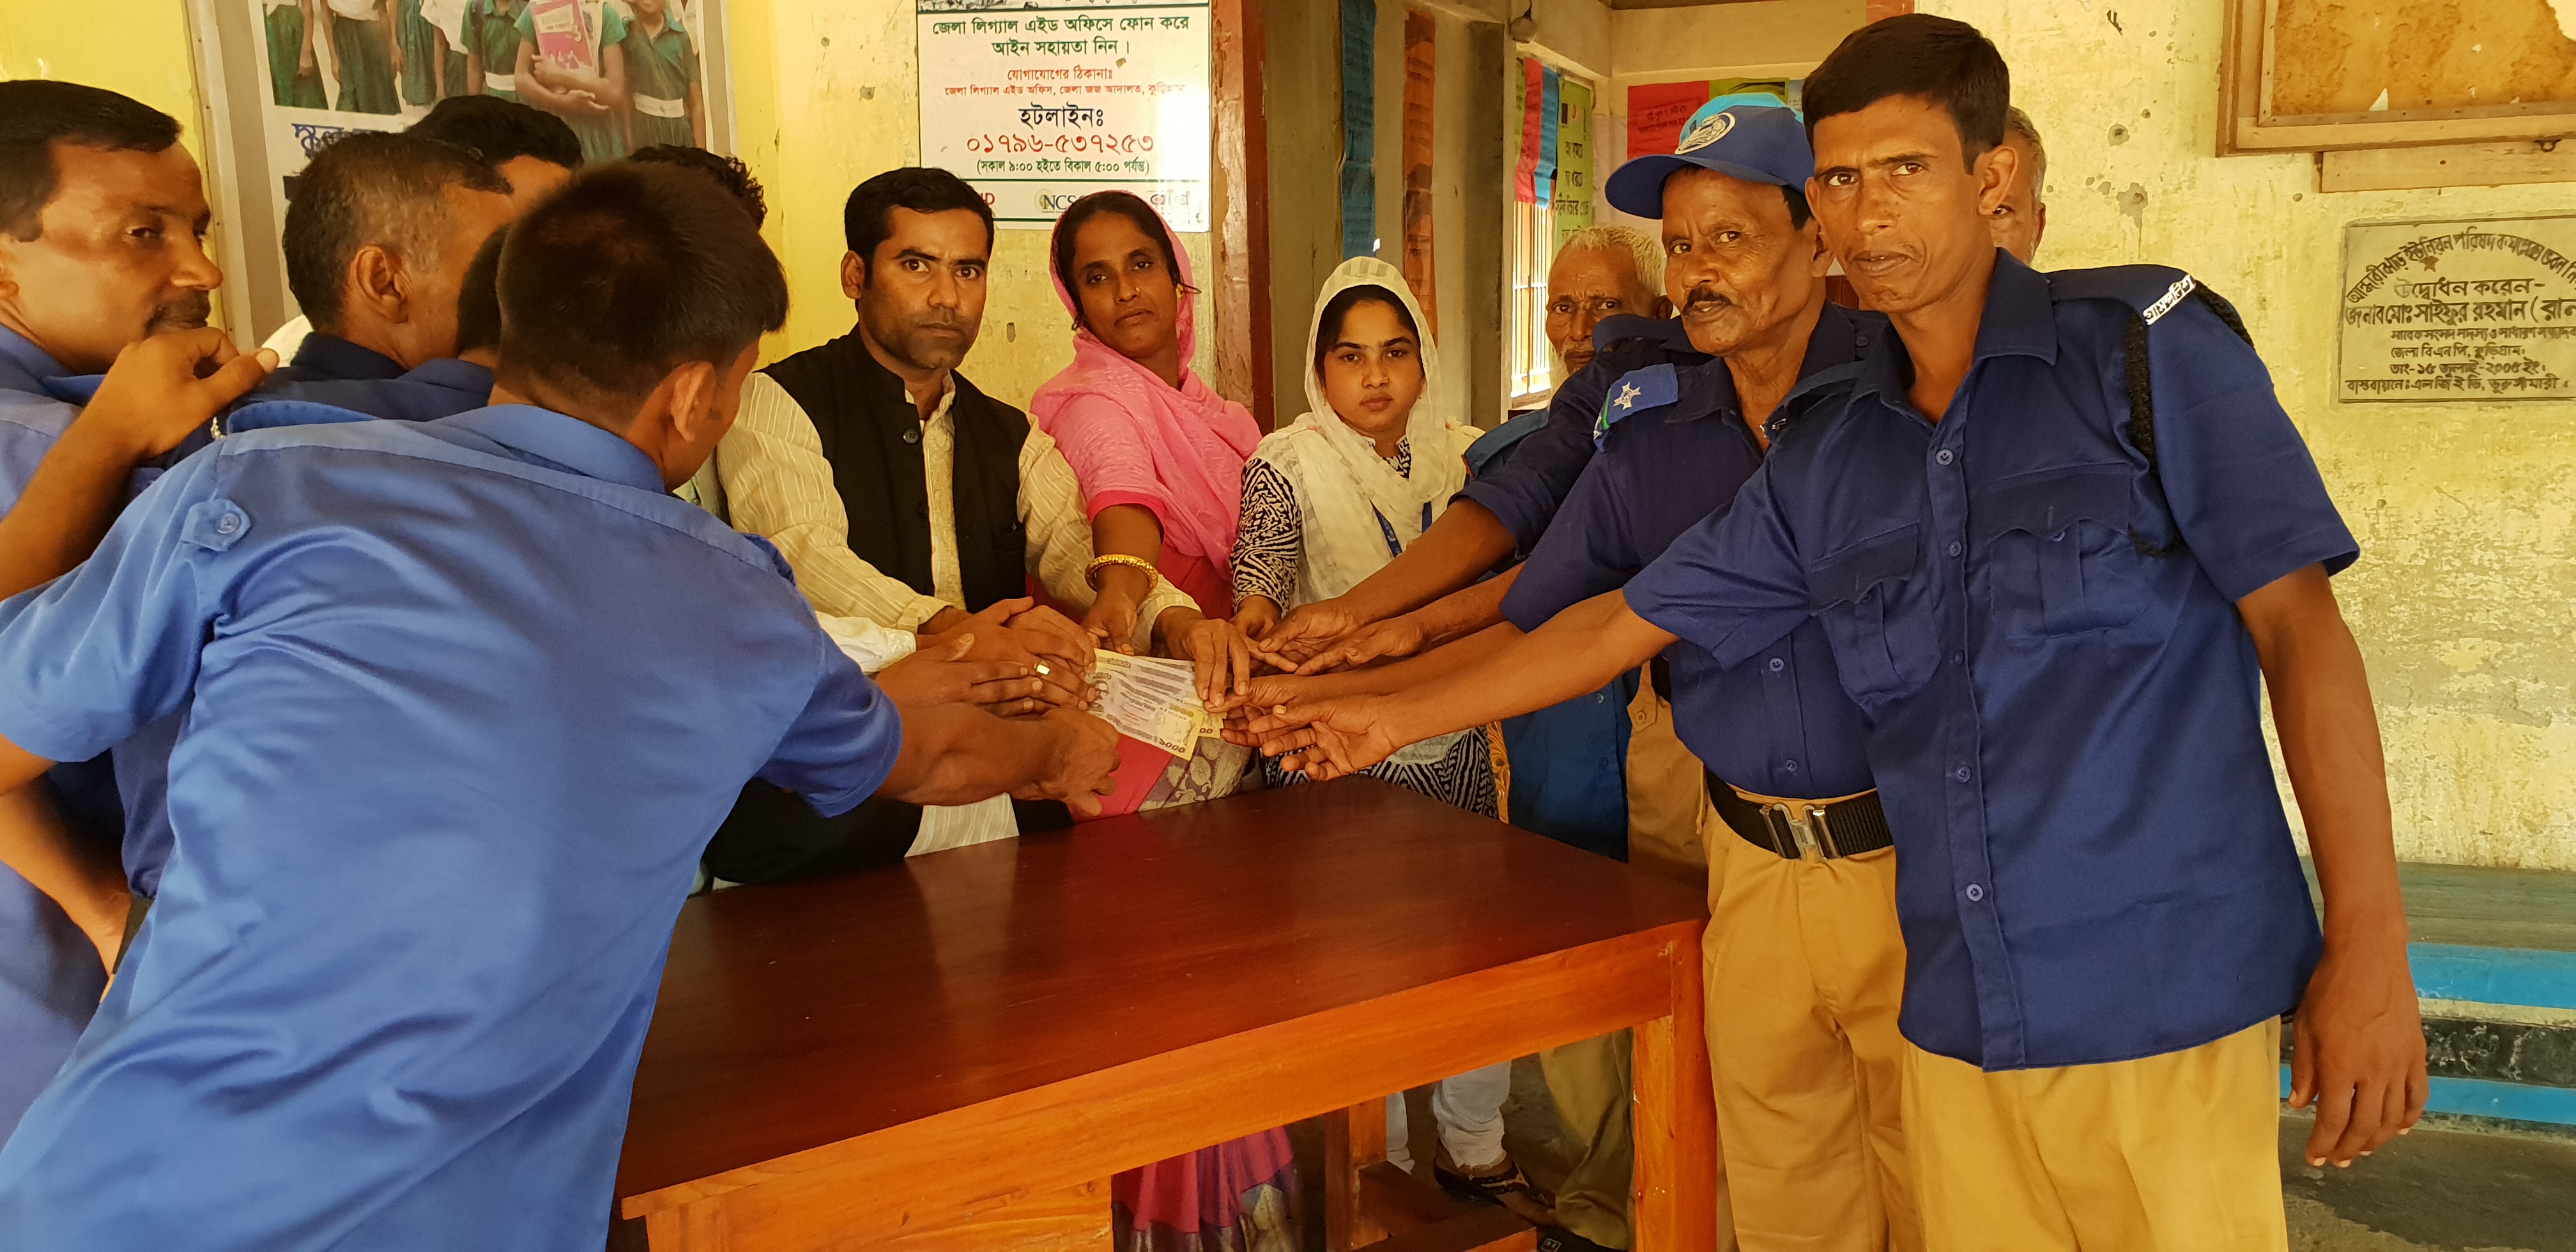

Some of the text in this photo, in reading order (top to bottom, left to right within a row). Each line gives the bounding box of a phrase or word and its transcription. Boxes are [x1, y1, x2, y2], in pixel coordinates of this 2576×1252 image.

[933, 14, 1190, 34] জেলা লিগ্যাল এইড অফিসে ফোন করে
[991, 38, 1030, 56] আইন
[1034, 39, 1087, 56] সহায়তা
[1092, 35, 1118, 54] নিন
[1008, 64, 1113, 80] যোগাযোগের ঠিকানাঃ
[945, 87, 967, 96] জেলা
[970, 84, 999, 95] লিগ্যাল
[1003, 85, 1023, 95] এইড
[1026, 83, 1056, 96] অফিস,
[1059, 85, 1082, 95] জেলা
[1085, 86, 1101, 95] জজ
[1018, 101, 1104, 130] হটলাইনঃ
[966, 133, 1154, 155] ০১৭৯৬-৫৩৭২৫৩
[976, 159, 1006, 176] (সকাল
[1036, 157, 1061, 172] হইতে
[1064, 156, 1091, 172] বিকাল
[1042, 194, 1086, 211] NCS
[2453, 225, 2496, 252] পরিষদ
[2345, 303, 2385, 328] জনাব
[2414, 298, 2469, 326] সাইফুর
[2472, 298, 2529, 321] রহমান
[2489, 328, 2497, 339] ও
[2391, 347, 2419, 359] জেলা
